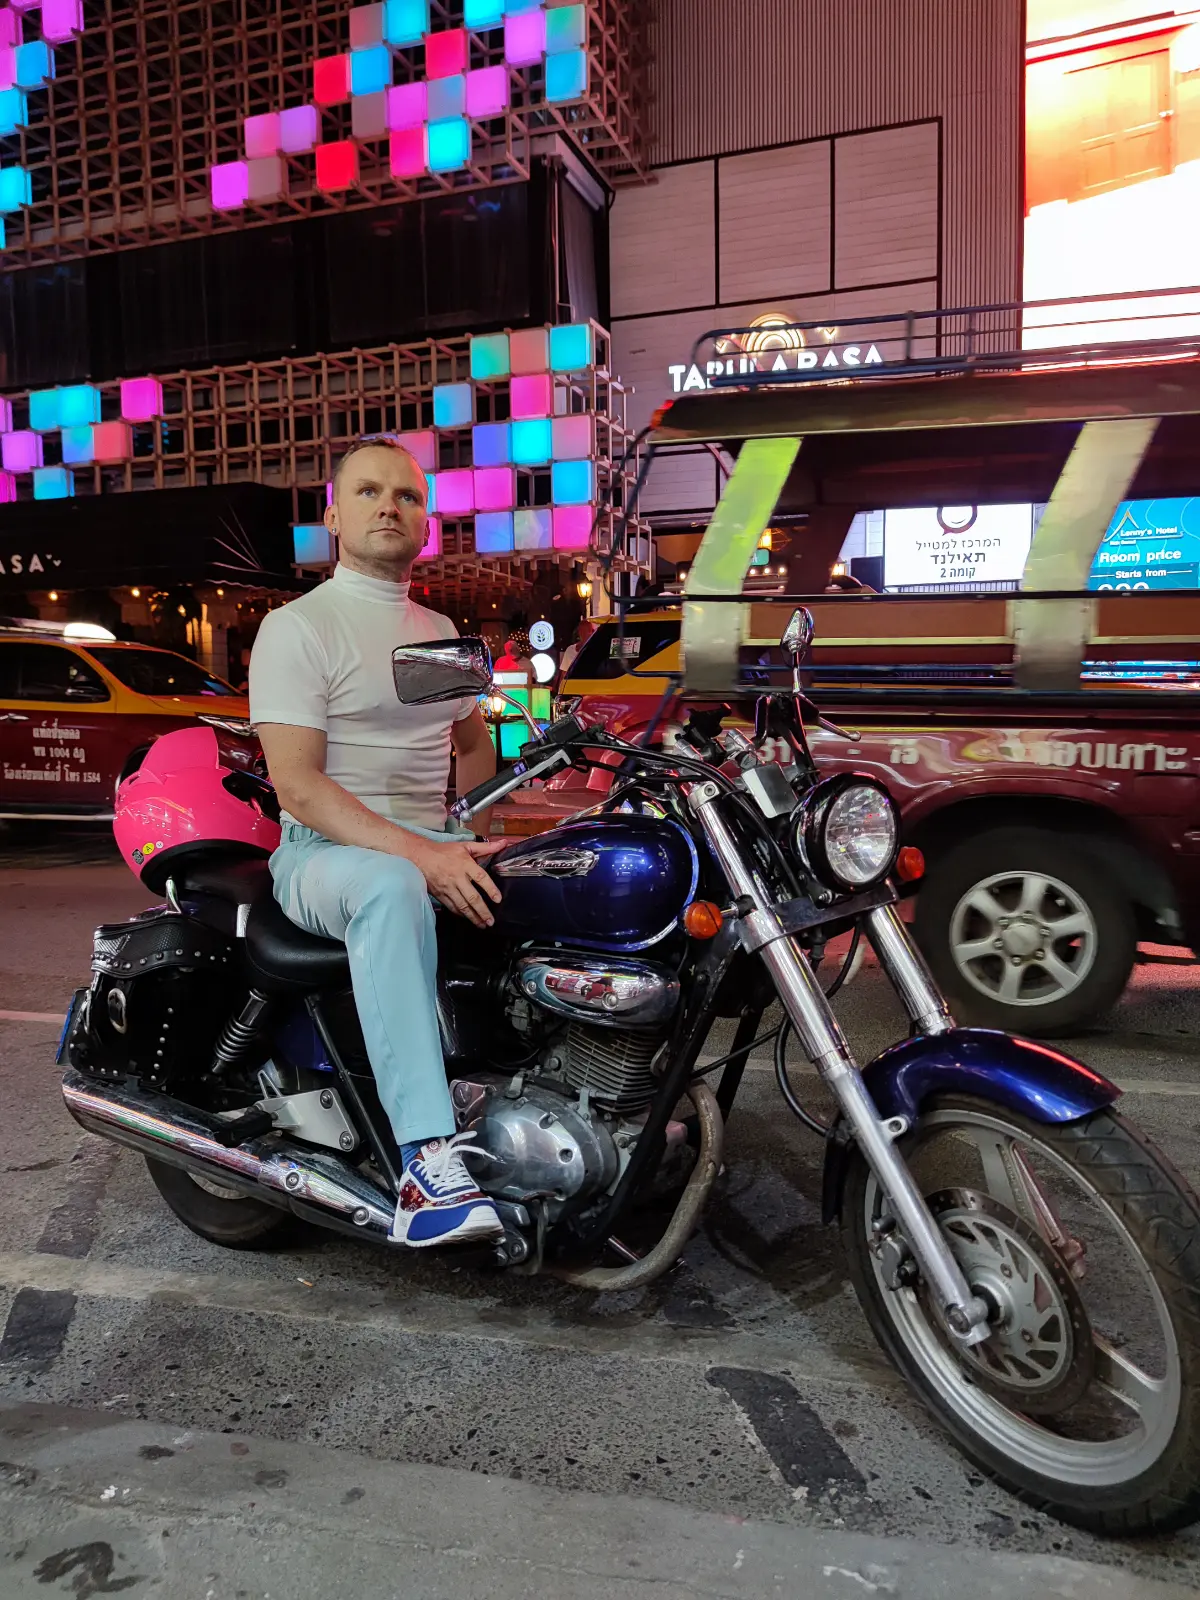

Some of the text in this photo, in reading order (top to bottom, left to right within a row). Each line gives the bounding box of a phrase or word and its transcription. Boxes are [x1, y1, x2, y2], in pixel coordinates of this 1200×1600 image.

[797, 344, 883, 369] RASA
[1155, 526, 1178, 534] Hotel
[916, 538, 1001, 551] המרכז למטייל
[930, 552, 986, 565] תאילנד
[1099, 550, 1182, 563] Room price
[940, 567, 976, 578] קומה 2
[1115, 569, 1167, 578] Starts from
[49, 747, 70, 758] 1004
[82, 771, 101, 783] 1584
